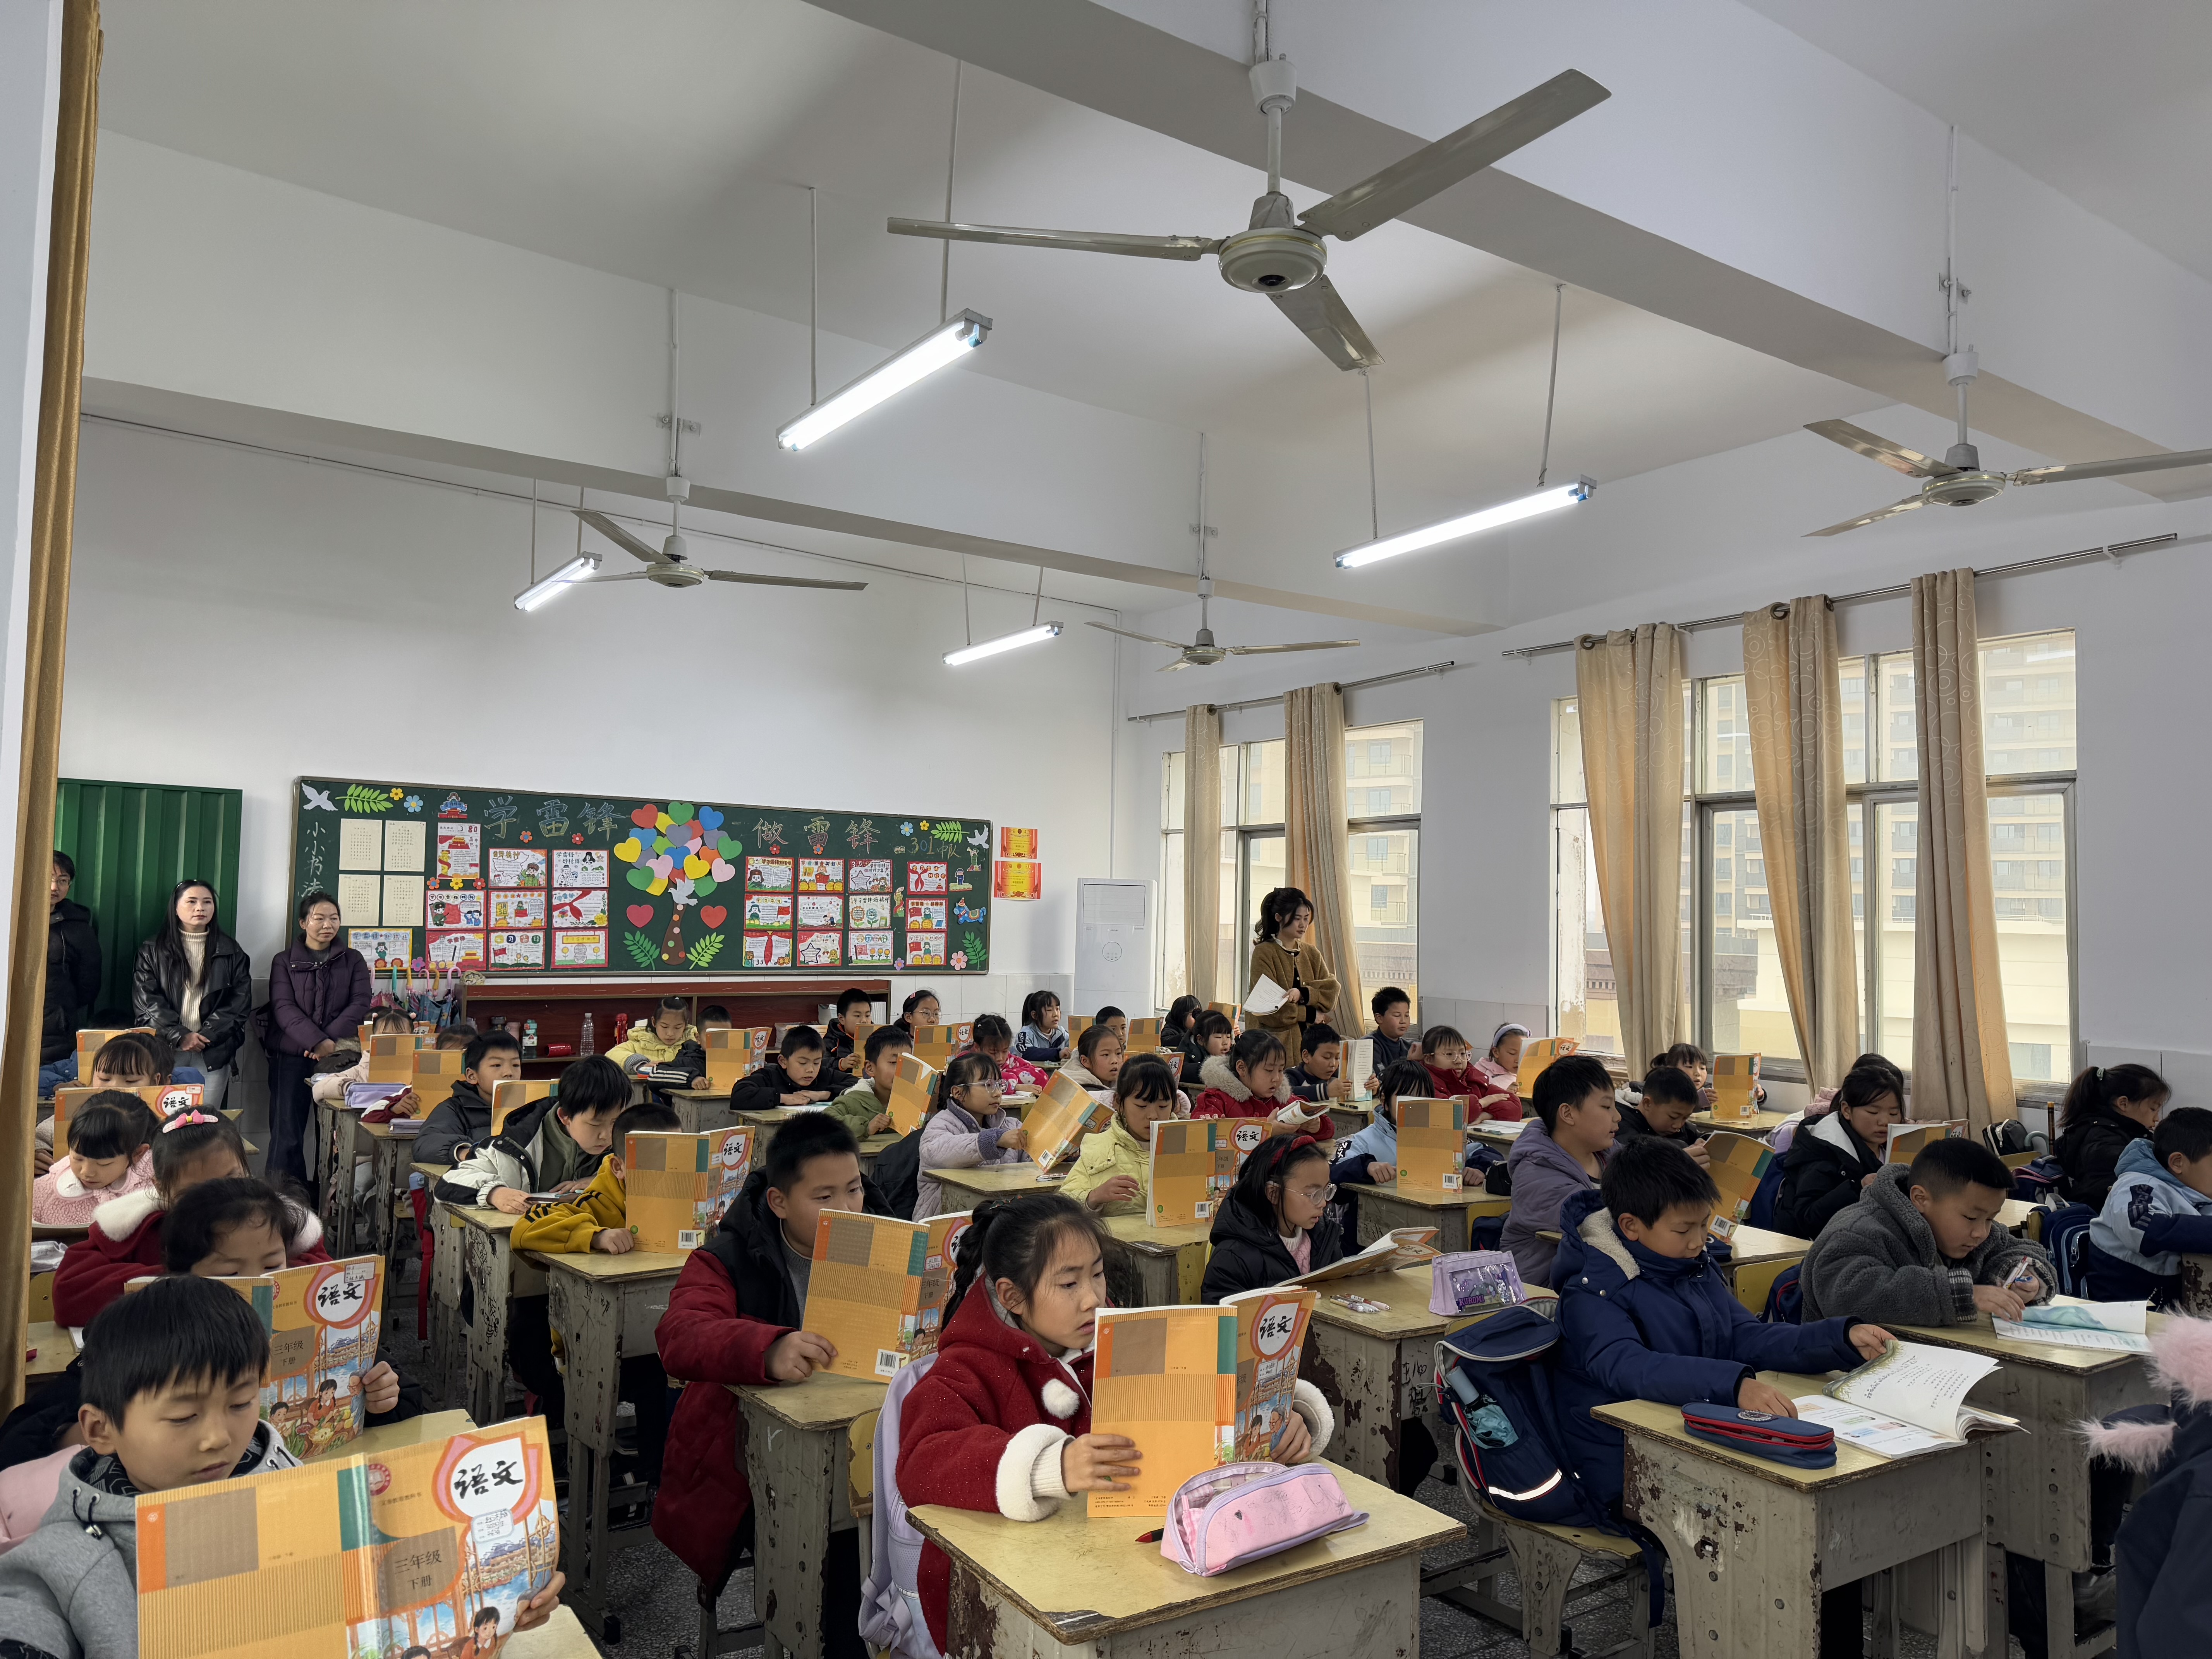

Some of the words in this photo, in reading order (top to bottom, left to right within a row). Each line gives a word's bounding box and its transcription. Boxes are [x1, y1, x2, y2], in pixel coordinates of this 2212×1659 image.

[484, 795, 626, 841] 学雷锋
[751, 816, 881, 854] 做雷锋
[163, 1097, 189, 1108] 语文
[1237, 1131, 1260, 1142] 语文
[723, 1142, 743, 1156] 语文
[318, 1283, 363, 1307] 语文
[1458, 1294, 1485, 1306] KUROMI
[1259, 1316, 1292, 1340] 语文
[274, 1340, 304, 1355] 三年级
[280, 1357, 296, 1366] 下册
[453, 1460, 524, 1499] 语文
[394, 1550, 442, 1574] 三年级
[408, 1575, 432, 1590] 下册
